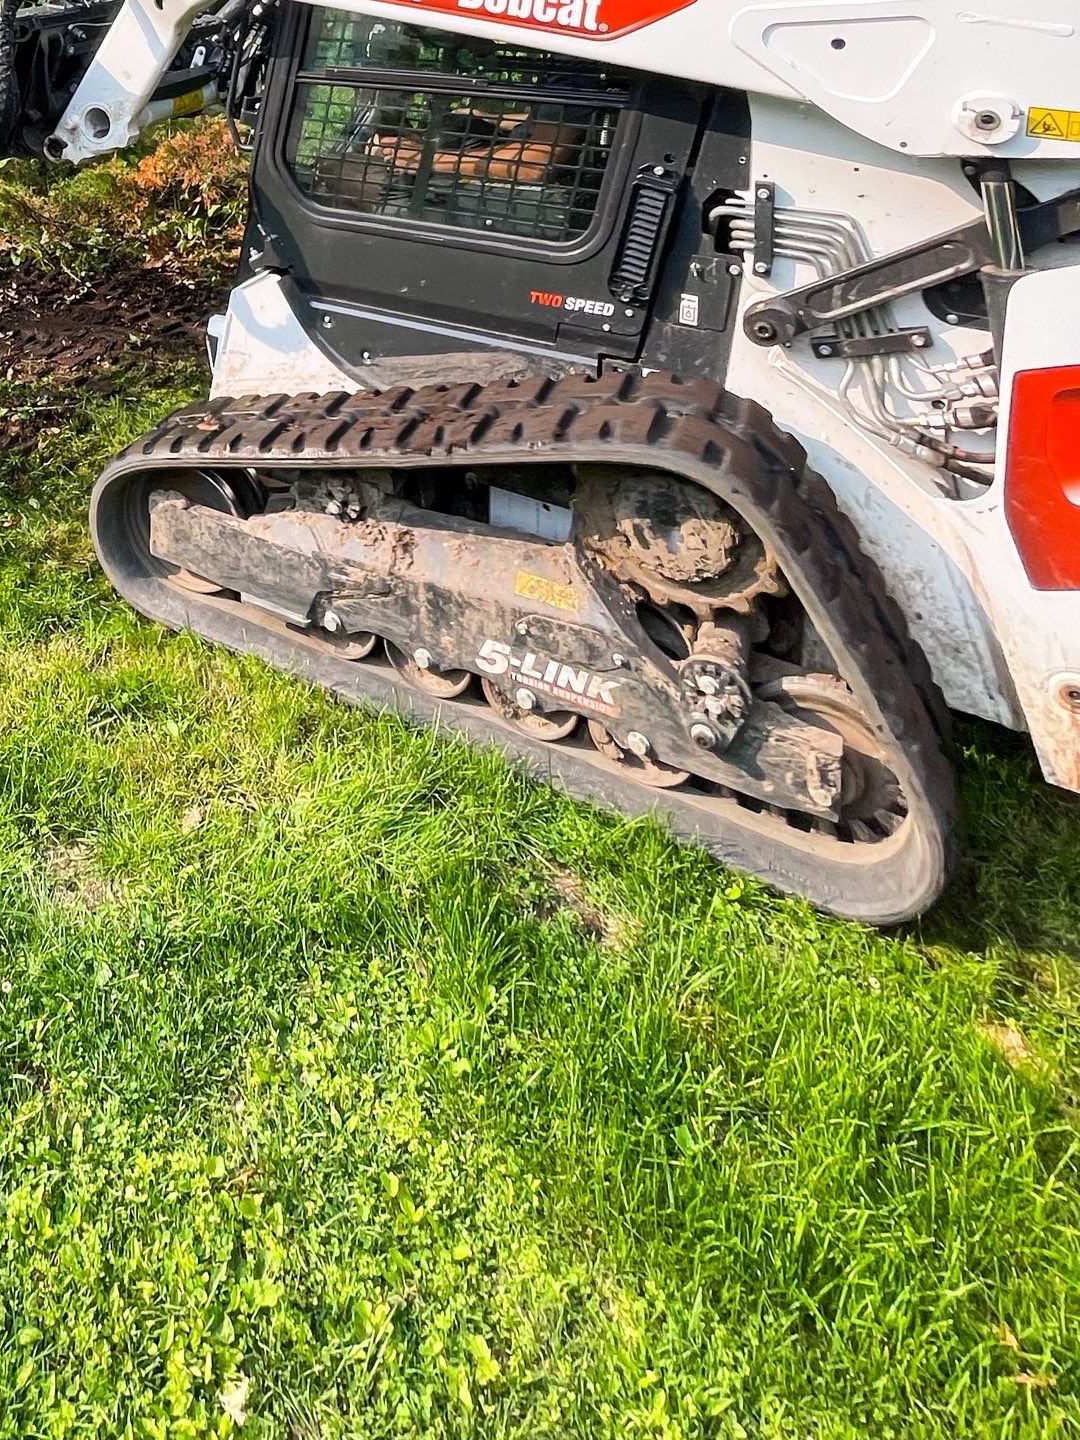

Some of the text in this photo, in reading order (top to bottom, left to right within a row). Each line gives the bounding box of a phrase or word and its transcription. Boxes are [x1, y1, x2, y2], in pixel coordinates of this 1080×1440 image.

[530, 291, 615, 317] TWO SPEED
[474, 639, 621, 706] 5-LINK
[510, 671, 608, 713] TORSION SUSPENSIO
